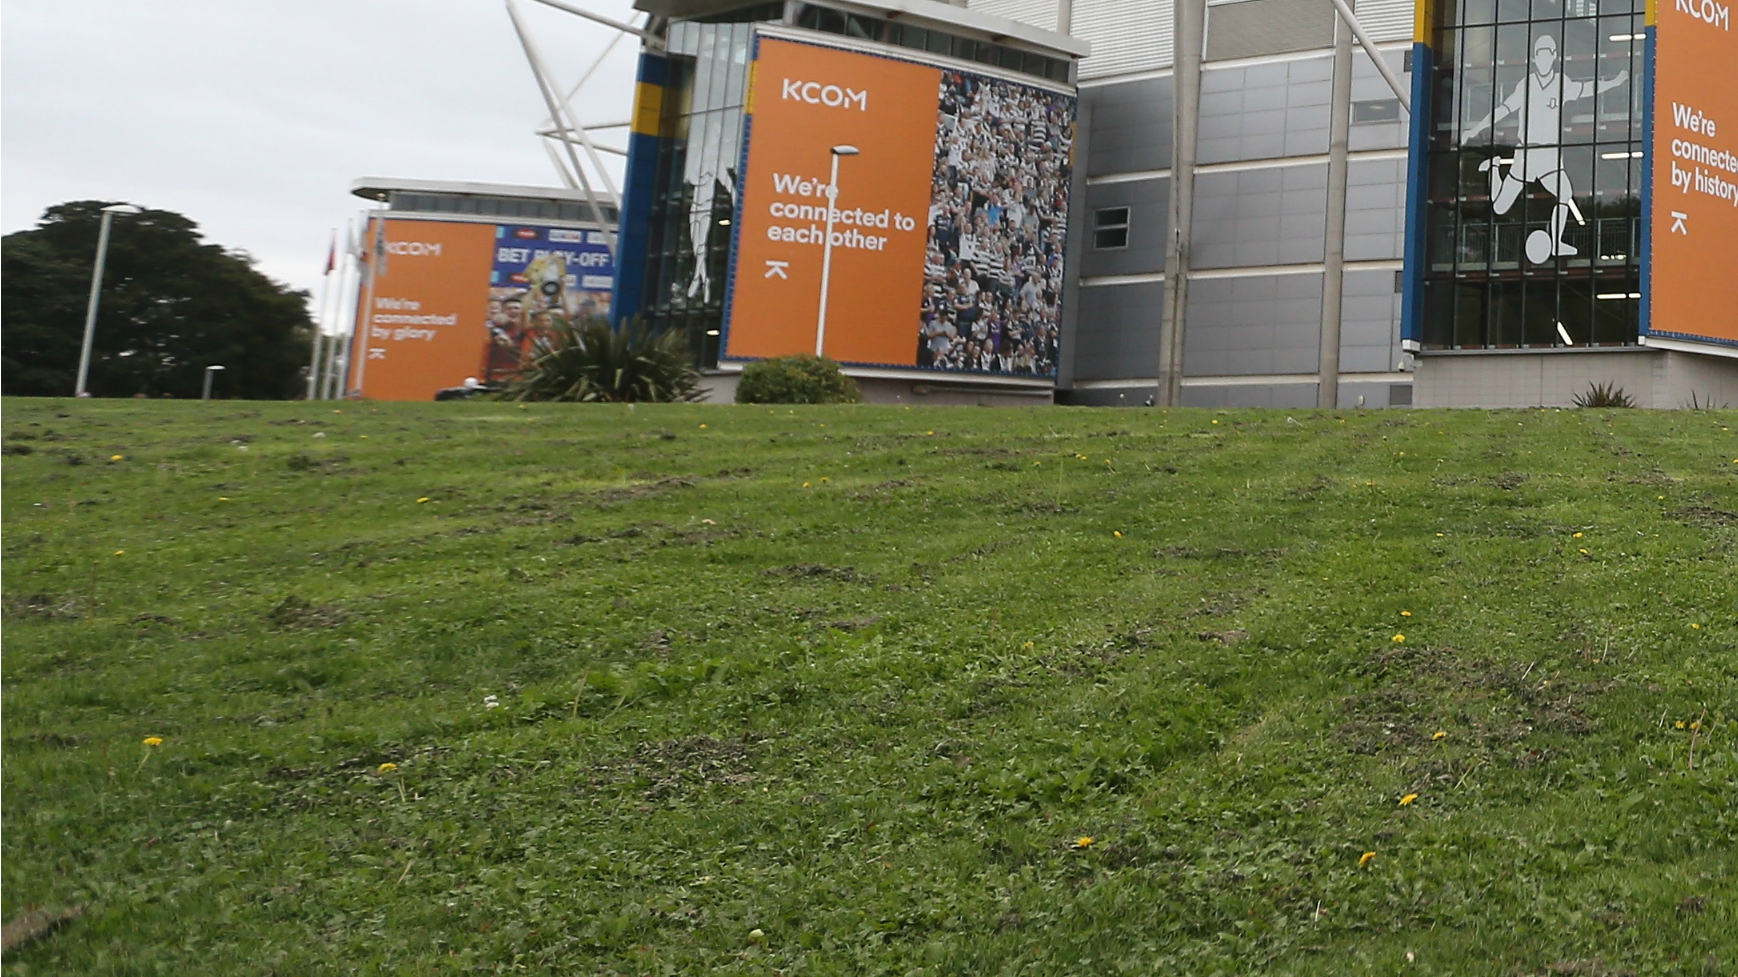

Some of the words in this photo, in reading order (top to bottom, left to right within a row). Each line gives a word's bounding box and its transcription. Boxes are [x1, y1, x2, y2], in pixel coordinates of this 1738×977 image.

[782, 78, 867, 111] KCOM
[1671, 160, 1692, 194] by
[769, 201, 890, 228] connected
[893, 212, 915, 231] to
[766, 224, 825, 245] each
[829, 228, 887, 251] other
[498, 248, 530, 262] BET
[534, 249, 609, 267] PY-OFF
[372, 325, 392, 340] by
[393, 326, 437, 341] glory
[374, 313, 458, 326] connected
